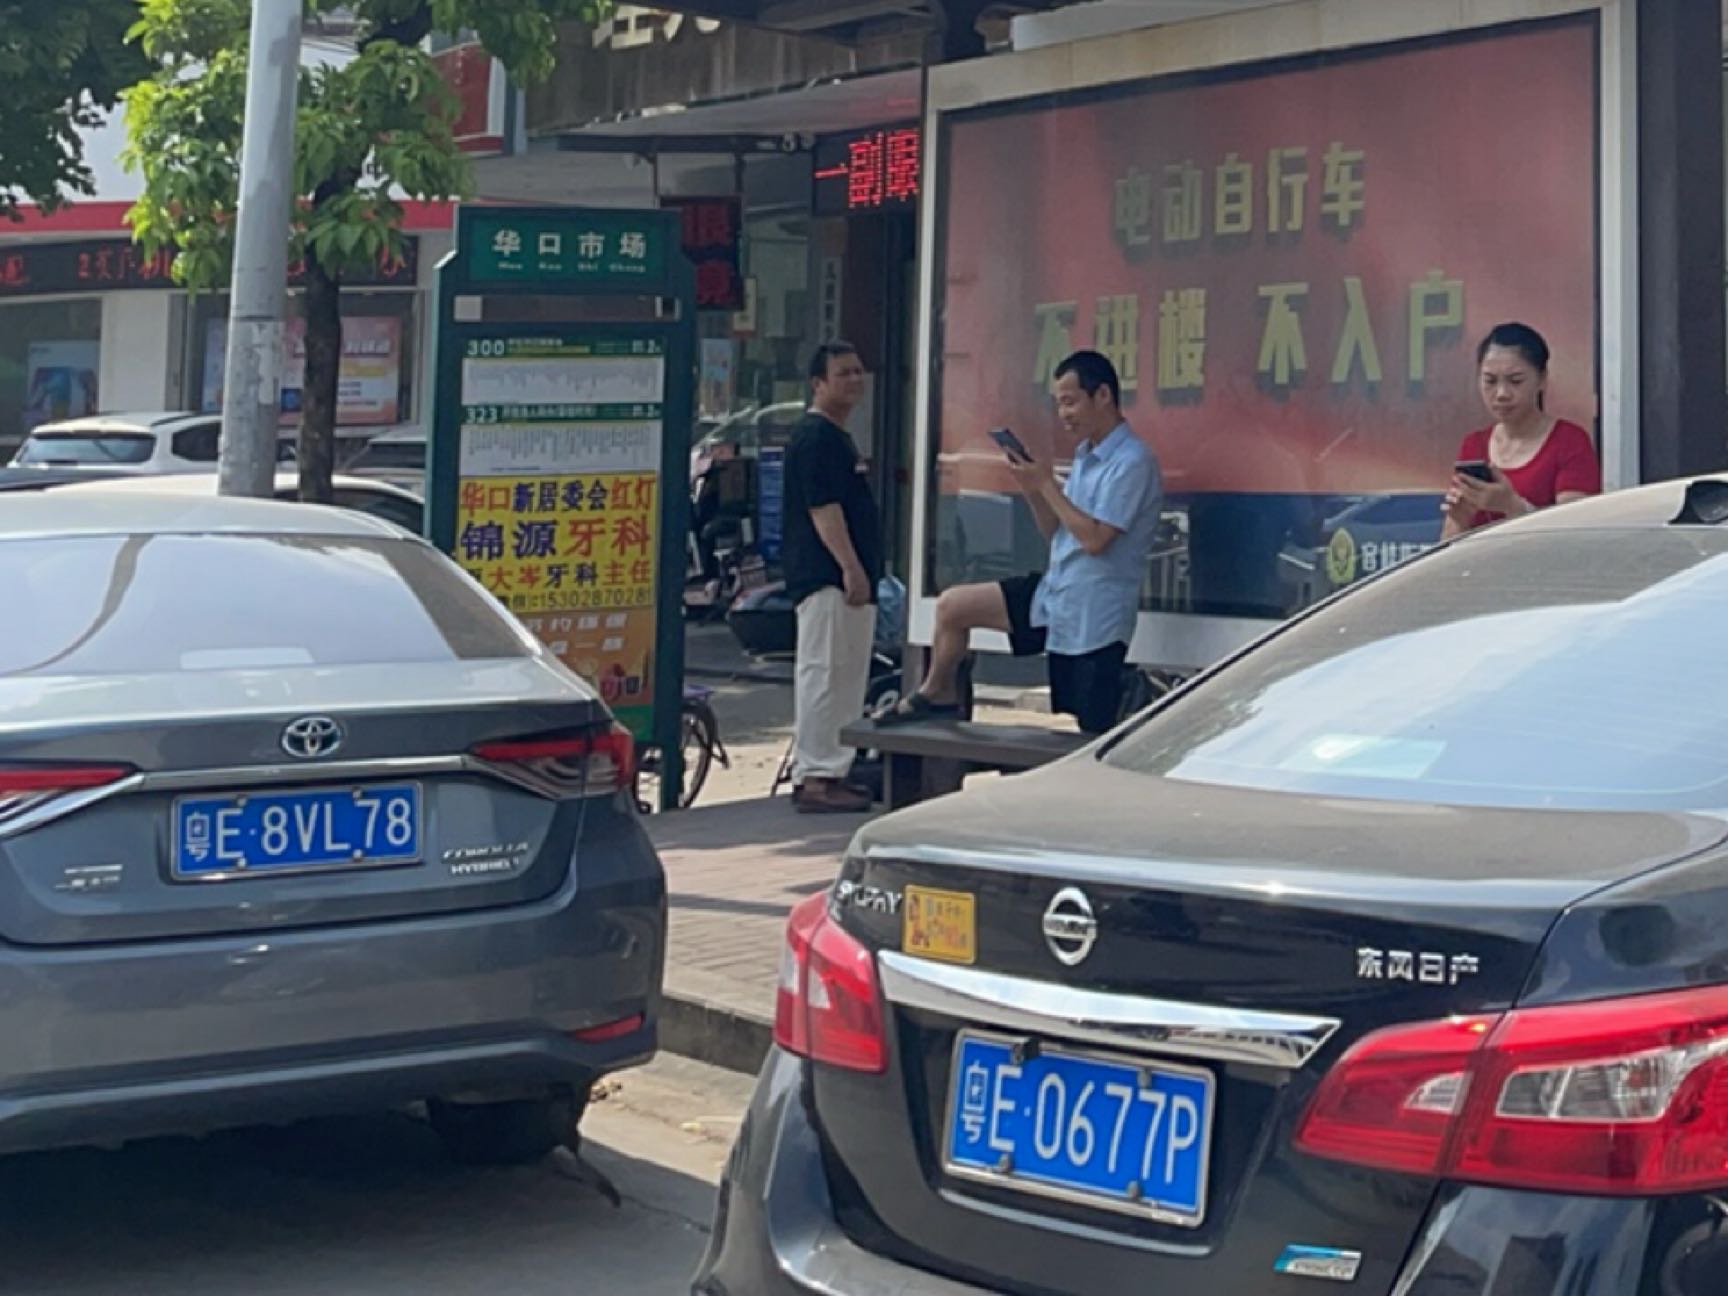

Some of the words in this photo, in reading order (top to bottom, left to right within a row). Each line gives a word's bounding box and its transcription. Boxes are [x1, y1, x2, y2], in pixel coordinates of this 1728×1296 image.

[1114, 140, 1366, 247] 电动自行车
[491, 229, 647, 259] 华口市场
[1257, 268, 1465, 385] 不入户
[467, 339, 505, 356] 300
[466, 406, 499, 424] 323
[460, 514, 651, 561] 锦源牙科
[1357, 948, 1479, 985] 东风日产
